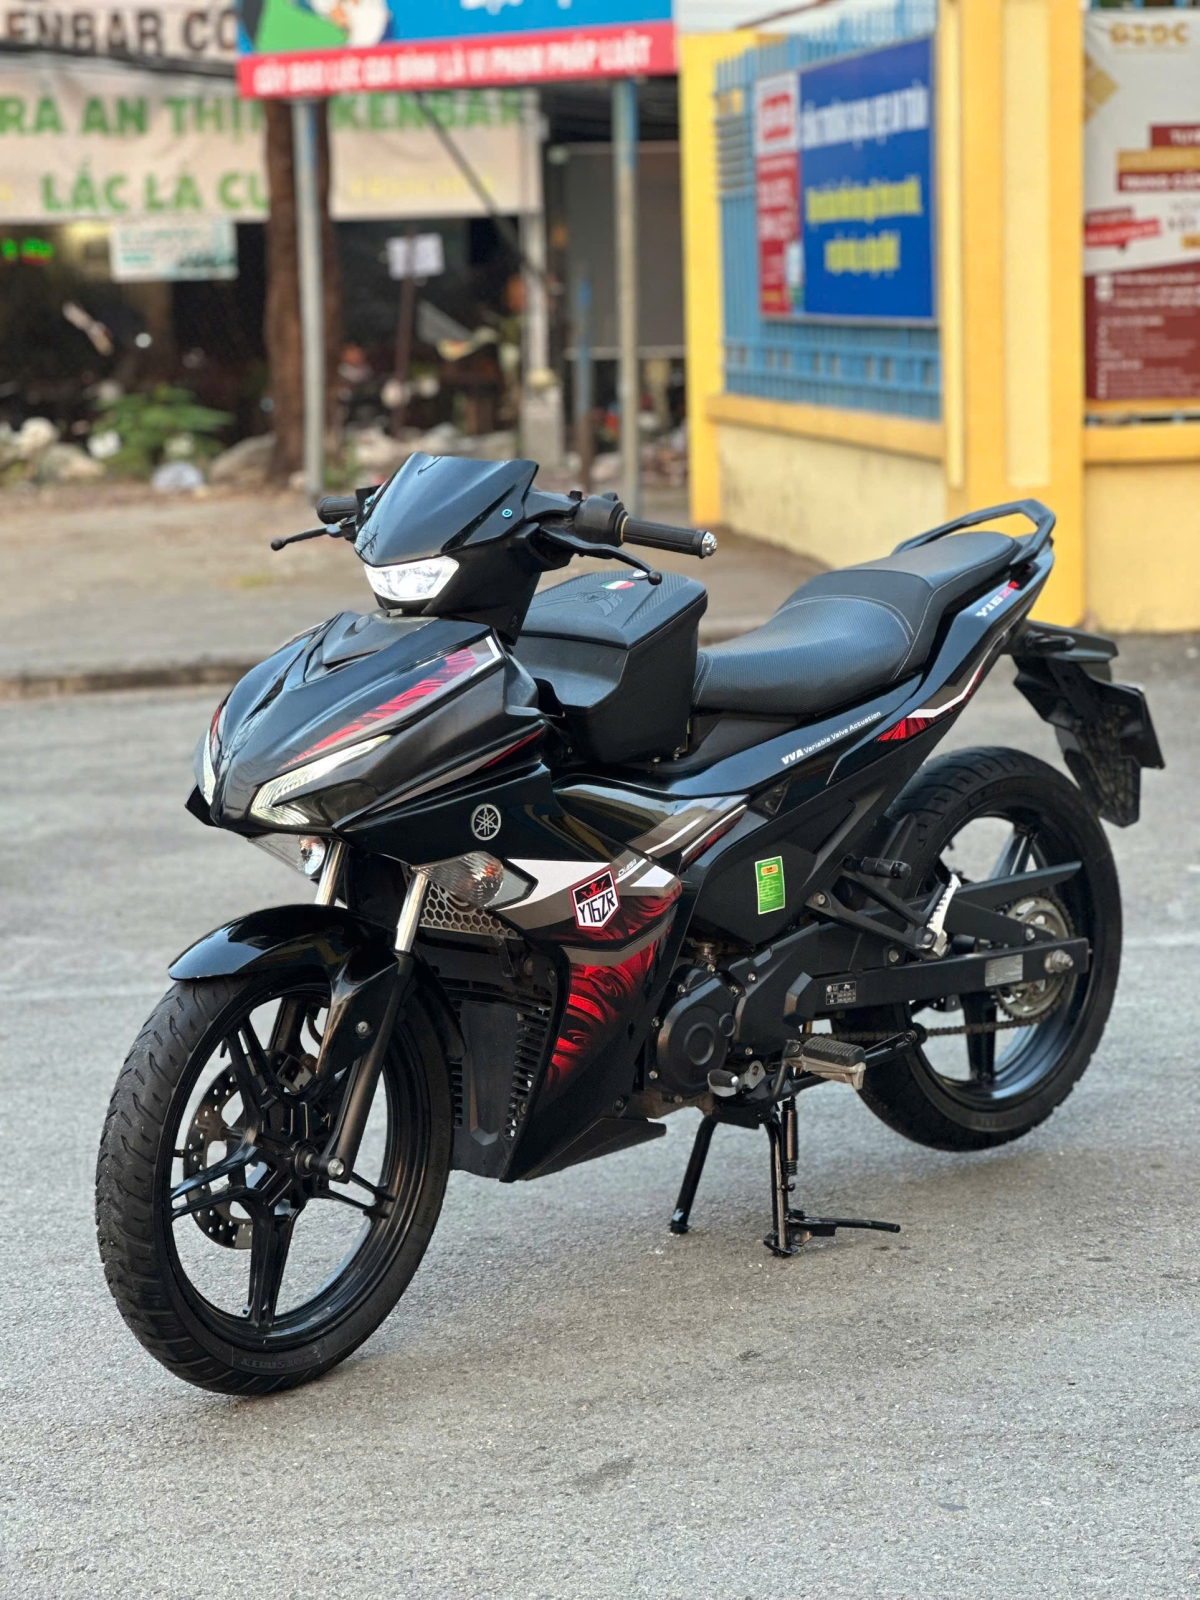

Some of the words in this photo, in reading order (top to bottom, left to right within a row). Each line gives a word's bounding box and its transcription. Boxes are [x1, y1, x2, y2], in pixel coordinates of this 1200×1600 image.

[79, 96, 149, 137] AN
[781, 748, 805, 765] VVA
[803, 736, 831, 754] Variable
[830, 728, 848, 741] Valve
[848, 711, 881, 731] Actuation
[578, 889, 616, 923] Y16ZR
